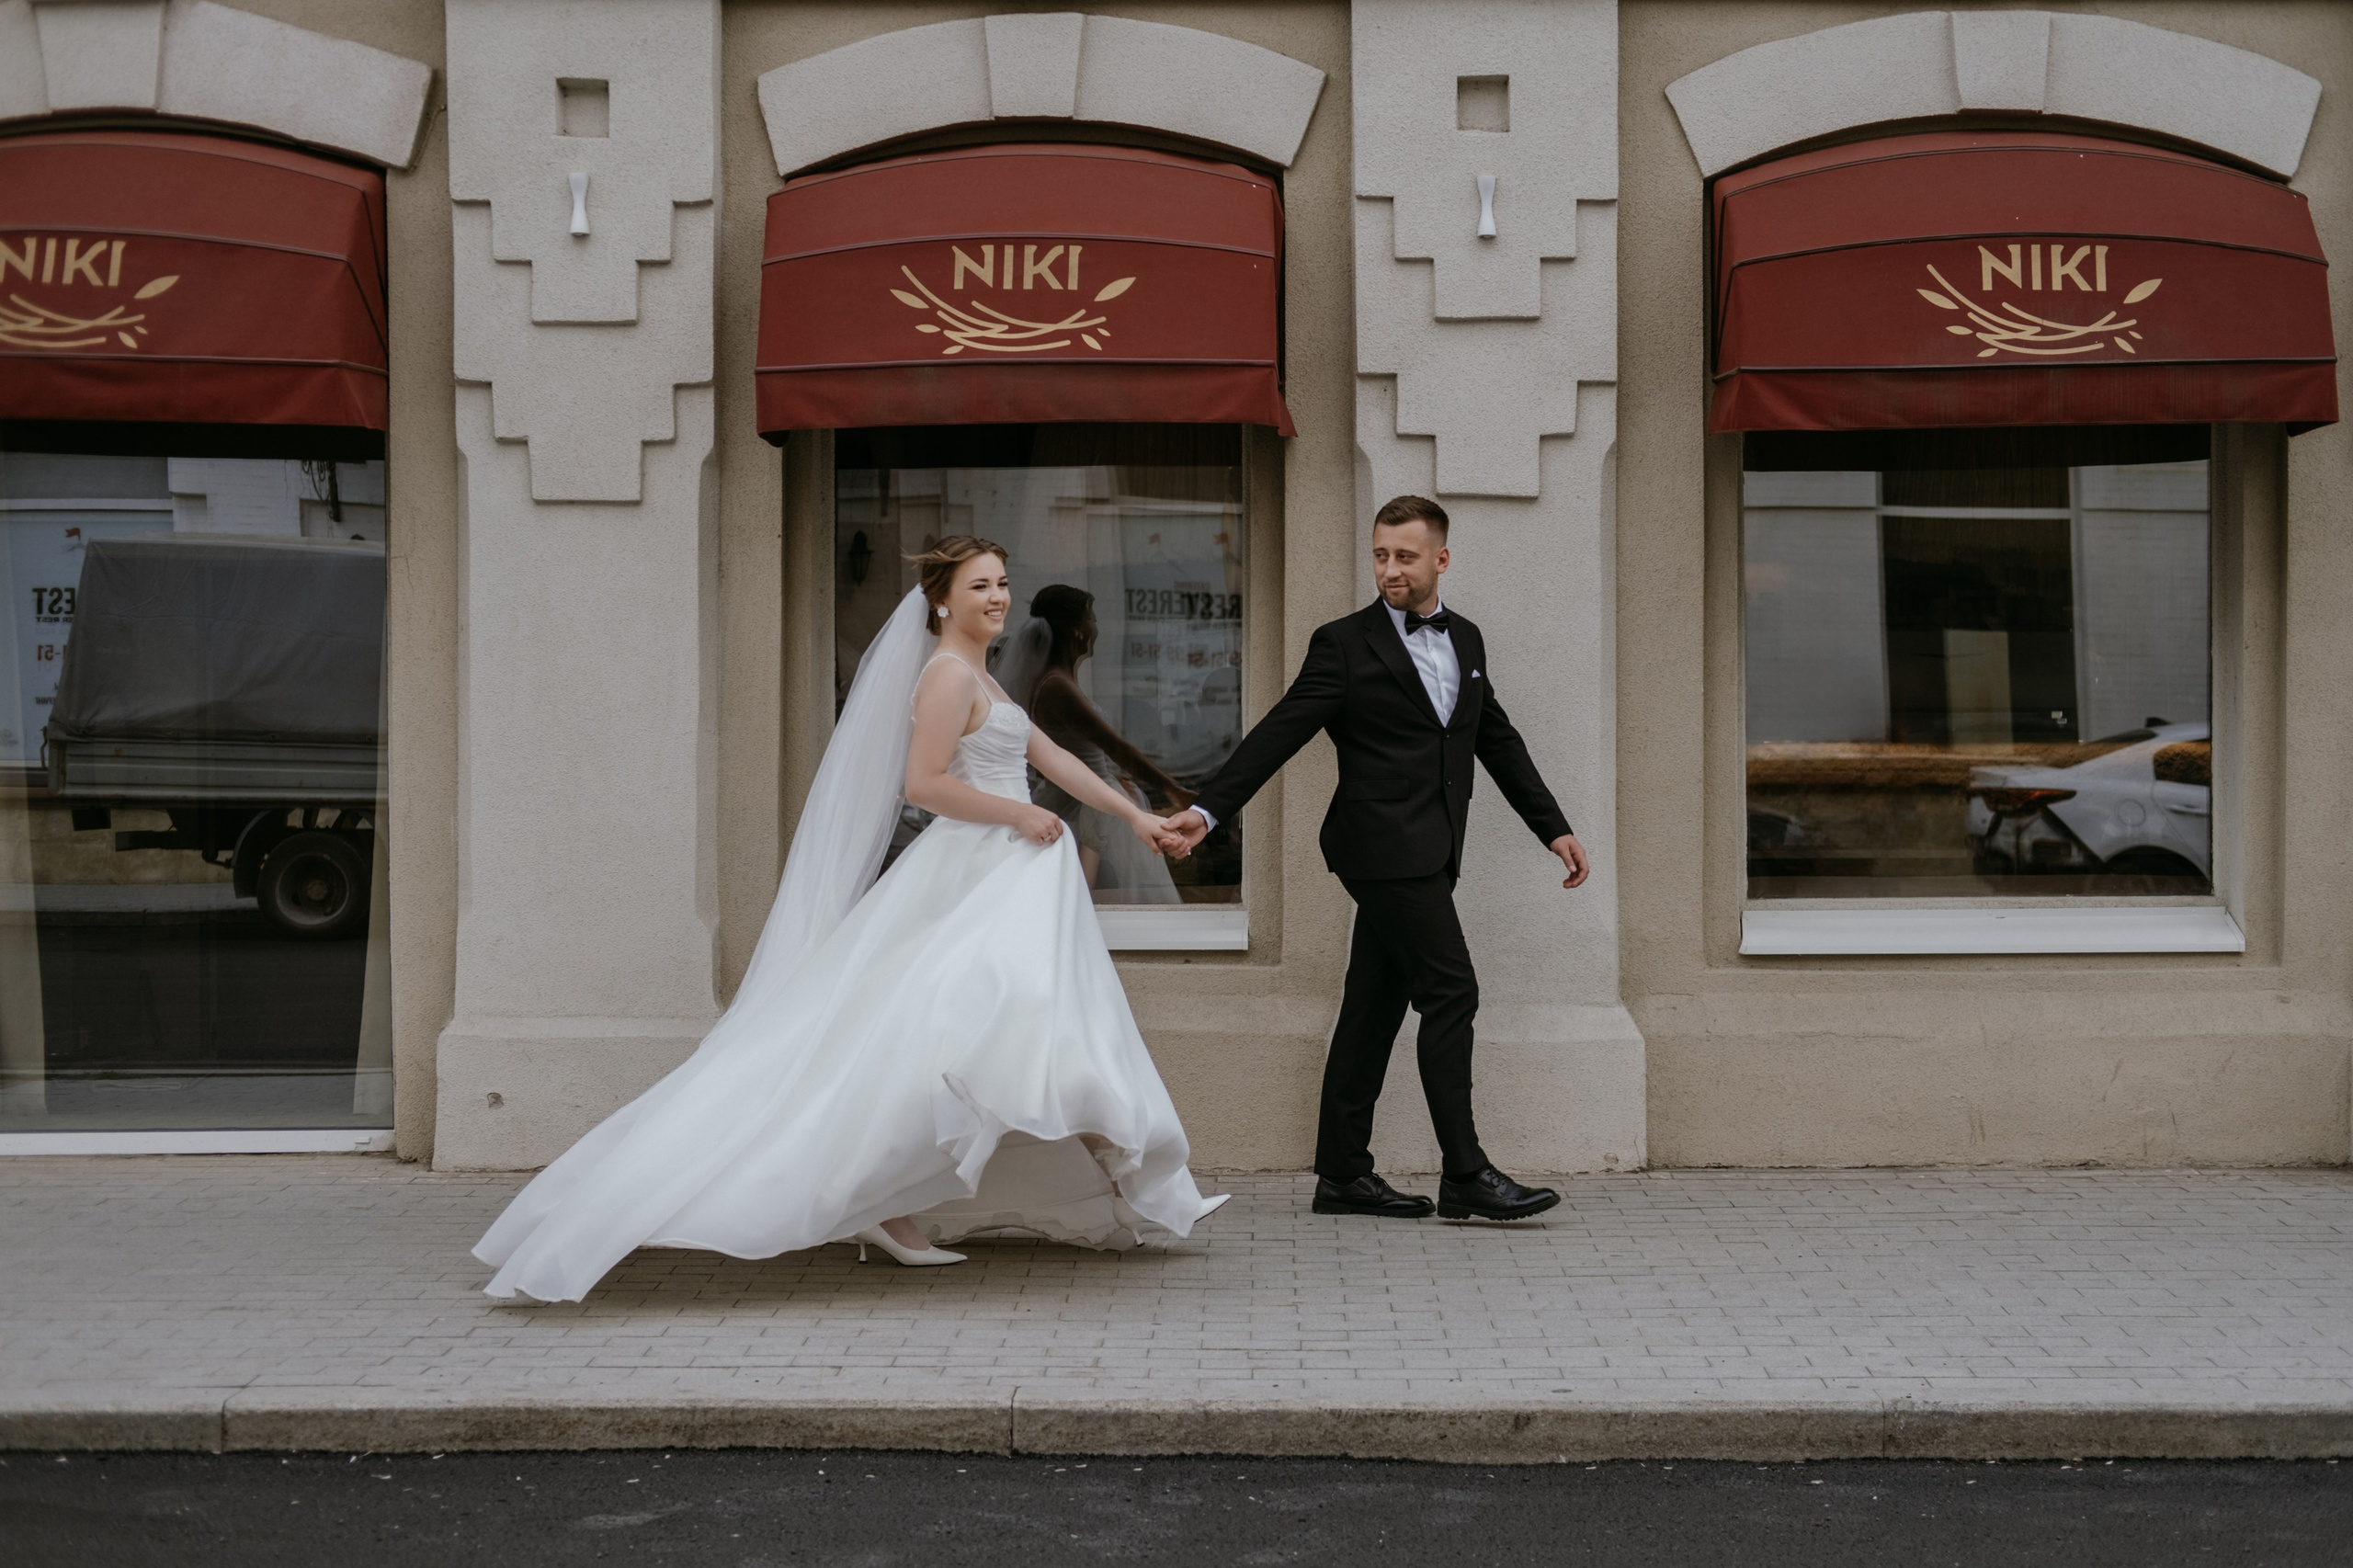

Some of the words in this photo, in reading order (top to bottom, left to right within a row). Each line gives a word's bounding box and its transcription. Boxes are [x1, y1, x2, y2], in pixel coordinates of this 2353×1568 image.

[0, 237, 127, 287] NIKI
[950, 244, 1084, 290] NIKI
[1977, 244, 2109, 292] NIKI
